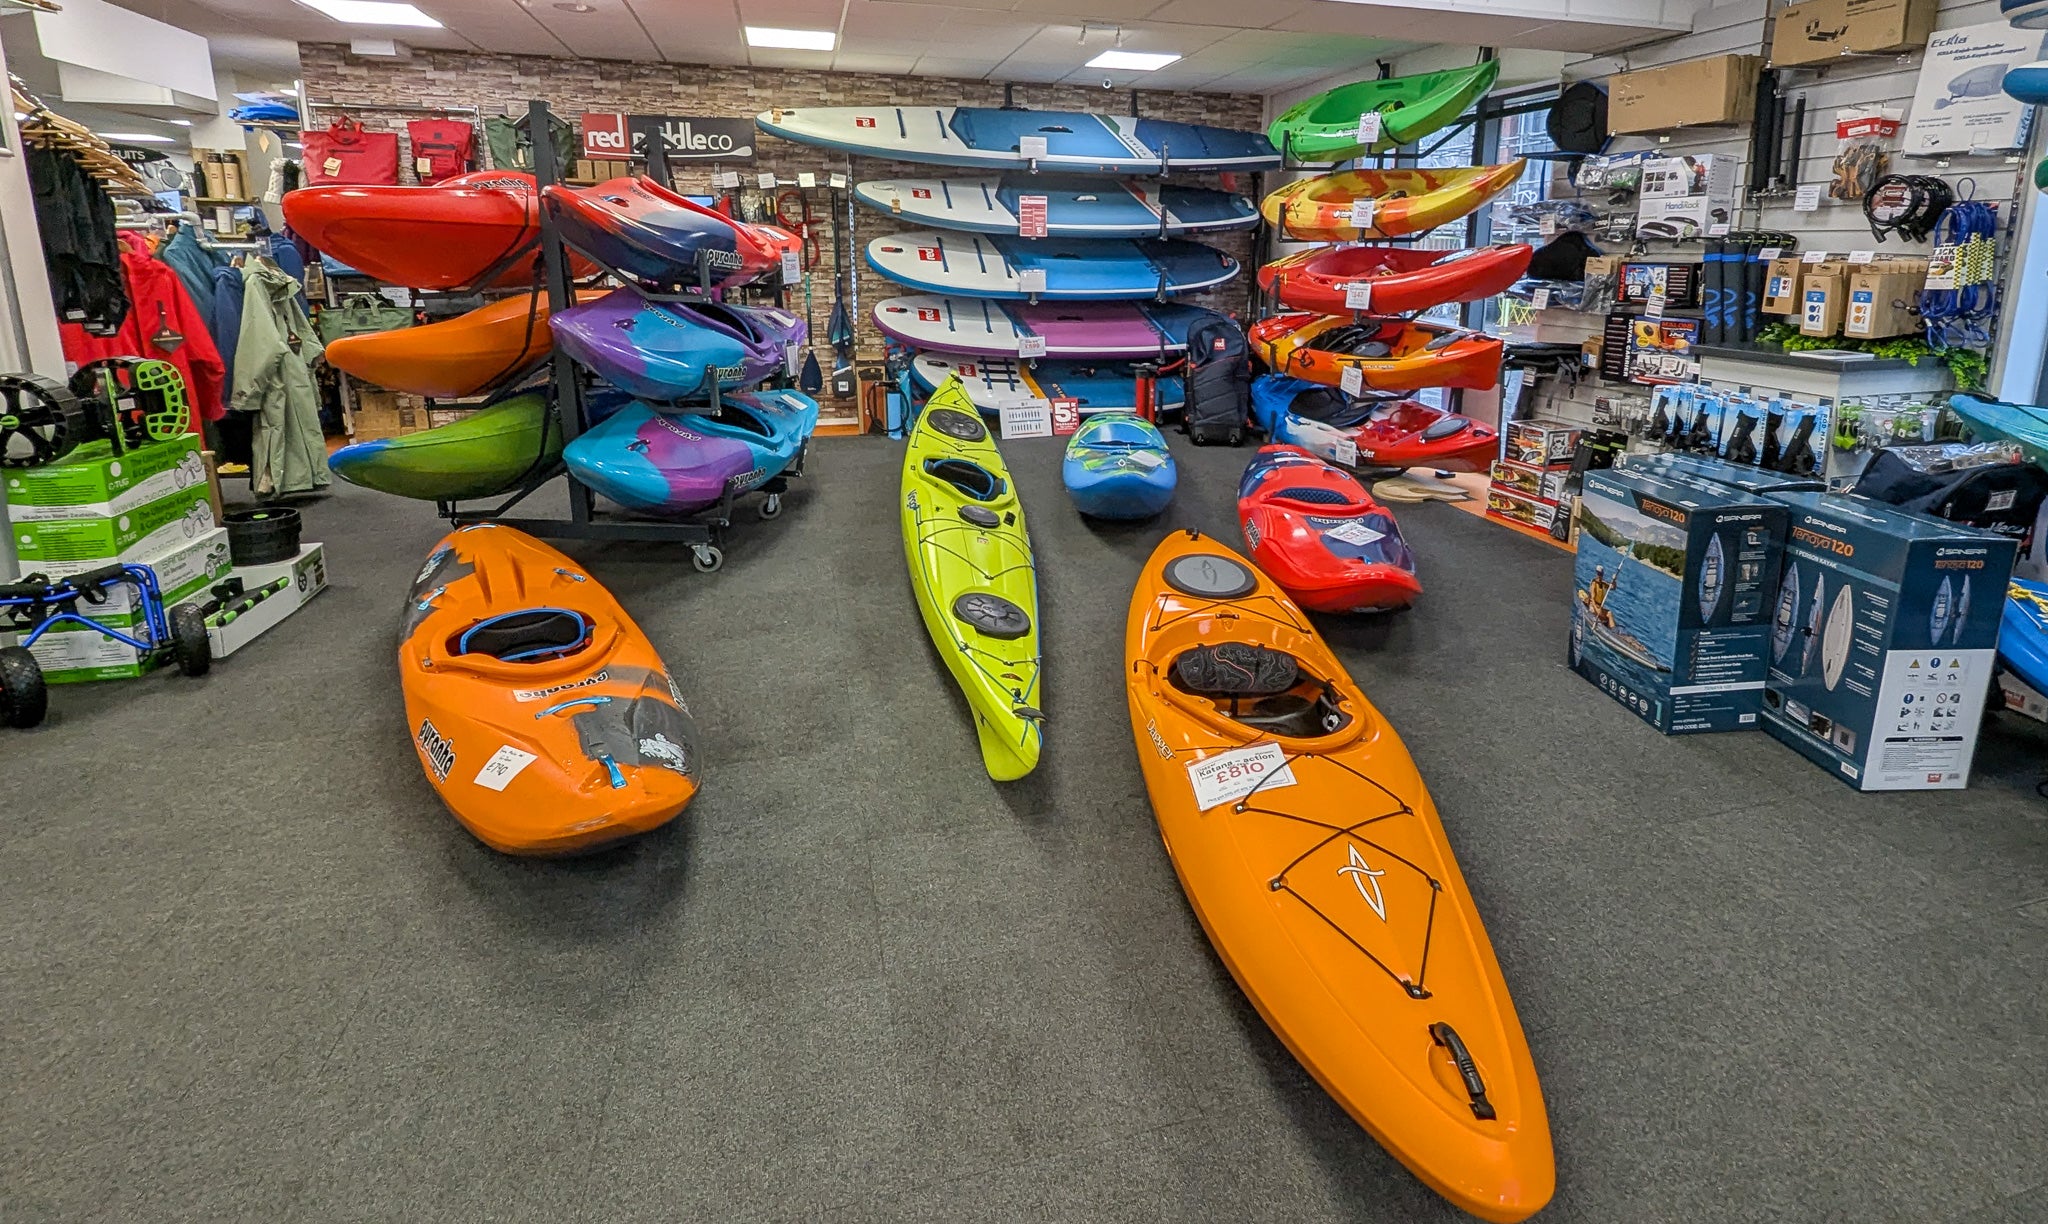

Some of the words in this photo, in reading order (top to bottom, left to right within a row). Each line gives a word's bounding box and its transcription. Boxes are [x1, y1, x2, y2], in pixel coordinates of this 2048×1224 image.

[1931, 34, 1968, 48] Eckla
[588, 114, 625, 148] red
[1665, 201, 1700, 210] HandiRack
[706, 249, 743, 267] pyranha
[1214, 338, 1225, 348] red
[1623, 344, 1632, 377] CARRIER
[1055, 402, 1071, 423] 5
[1594, 482, 1624, 498] SPINERA
[1669, 508, 1685, 523] 120
[1723, 514, 1762, 522] SPINERA
[1811, 519, 1847, 534] SPINERA
[1792, 526, 1832, 550] Tenaya
[1831, 540, 1854, 557] 120
[1799, 550, 1819, 564] PERSON
[1819, 557, 1838, 569] KAYAK
[1967, 560, 1984, 569] 120
[518, 671, 607, 701] pyranha
[418, 718, 456, 776] pyranha
[1146, 718, 1176, 760] Dagger
[1199, 760, 1233, 777] Katana
[1243, 752, 1275, 764] action
[1216, 762, 1265, 784] £810
